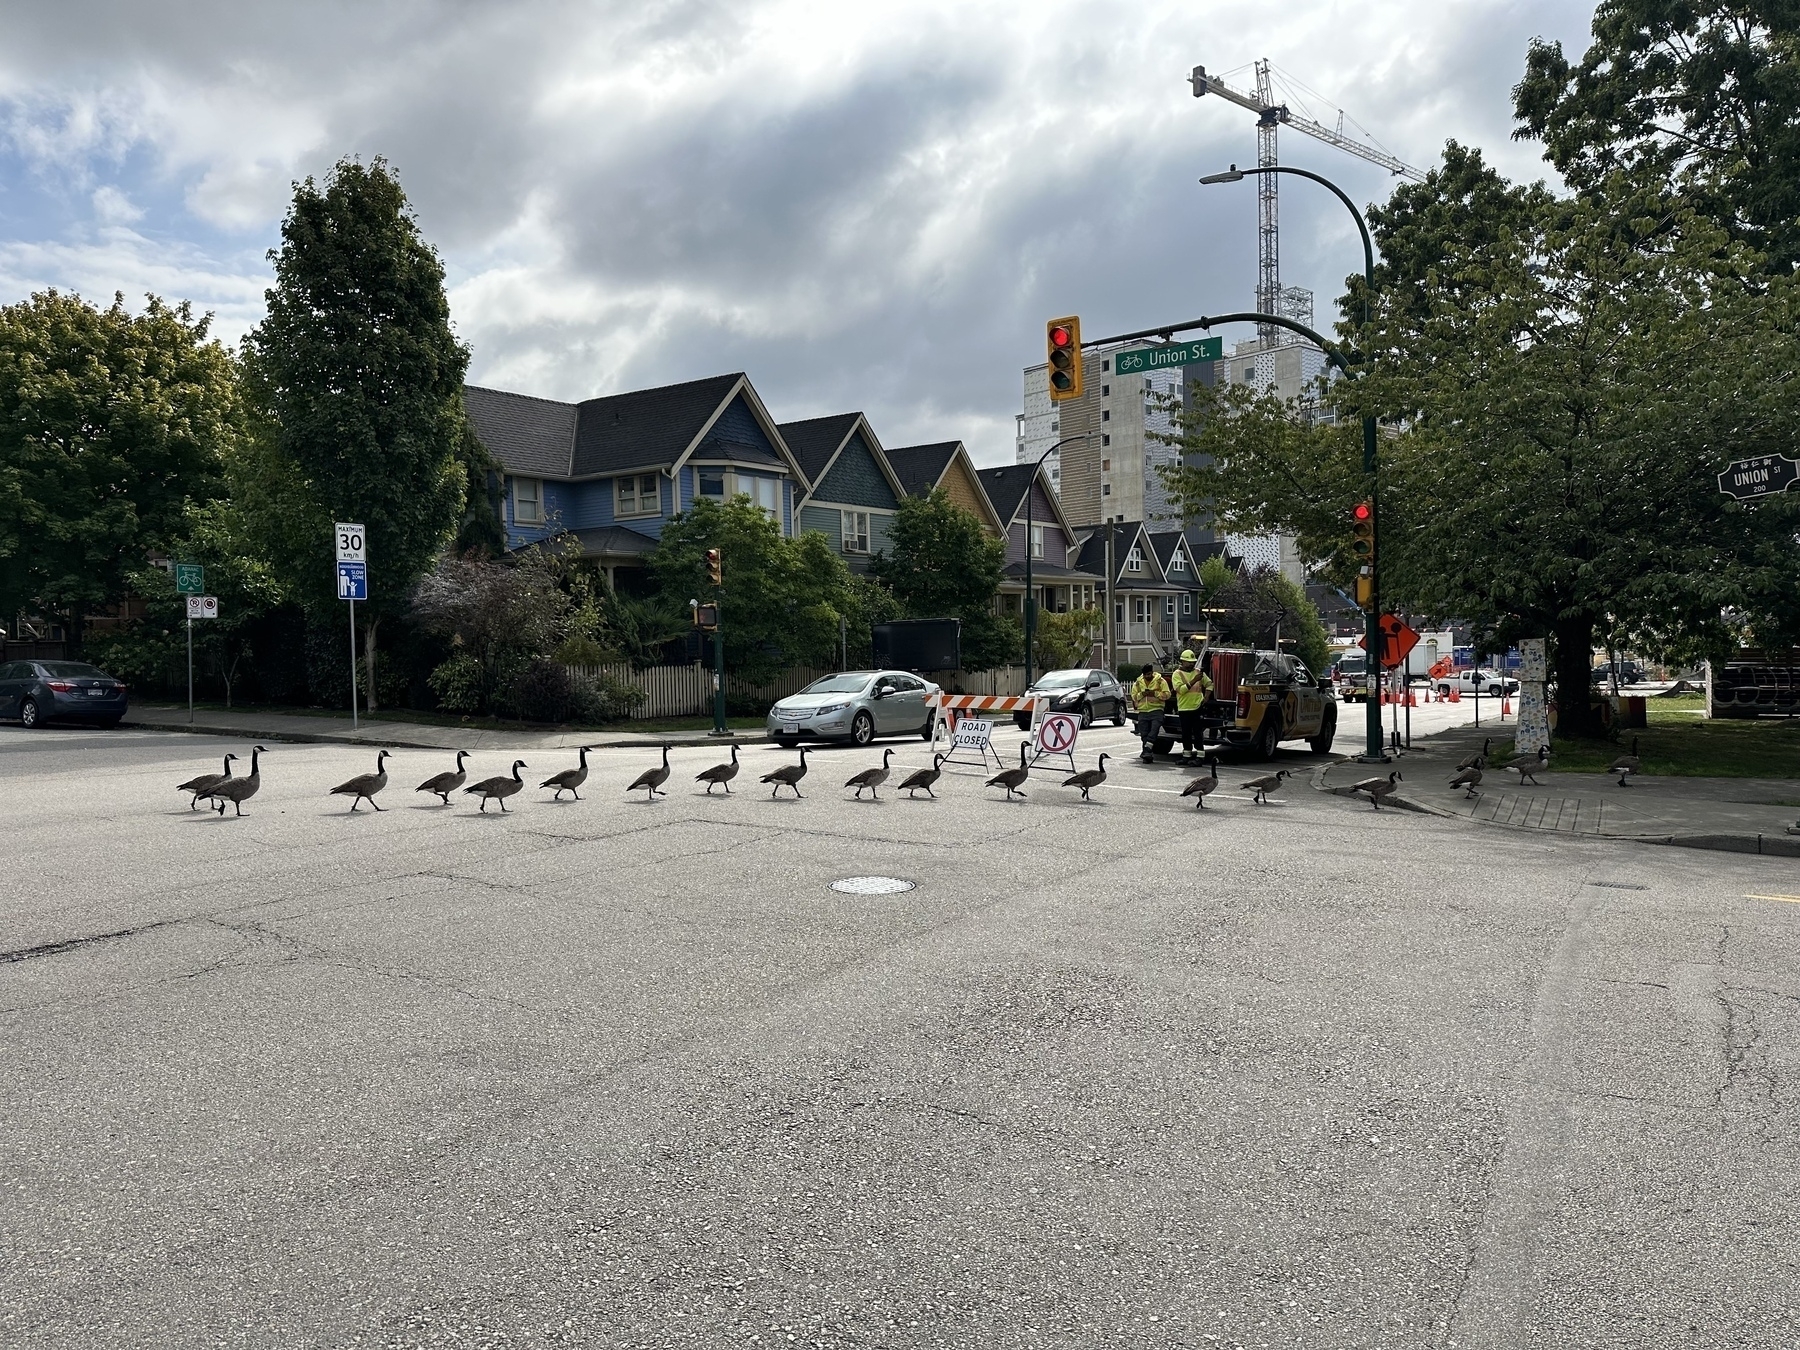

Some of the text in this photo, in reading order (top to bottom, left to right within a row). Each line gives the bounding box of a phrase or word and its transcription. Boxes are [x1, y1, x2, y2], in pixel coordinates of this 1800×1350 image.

[1149, 344, 1210, 366] Union St.
[1734, 465, 1781, 486] UNION ST
[1753, 484, 1767, 493] 200
[339, 533, 362, 551] 30
[961, 721, 986, 732] ROAD
[954, 734, 987, 746] CLOSED
